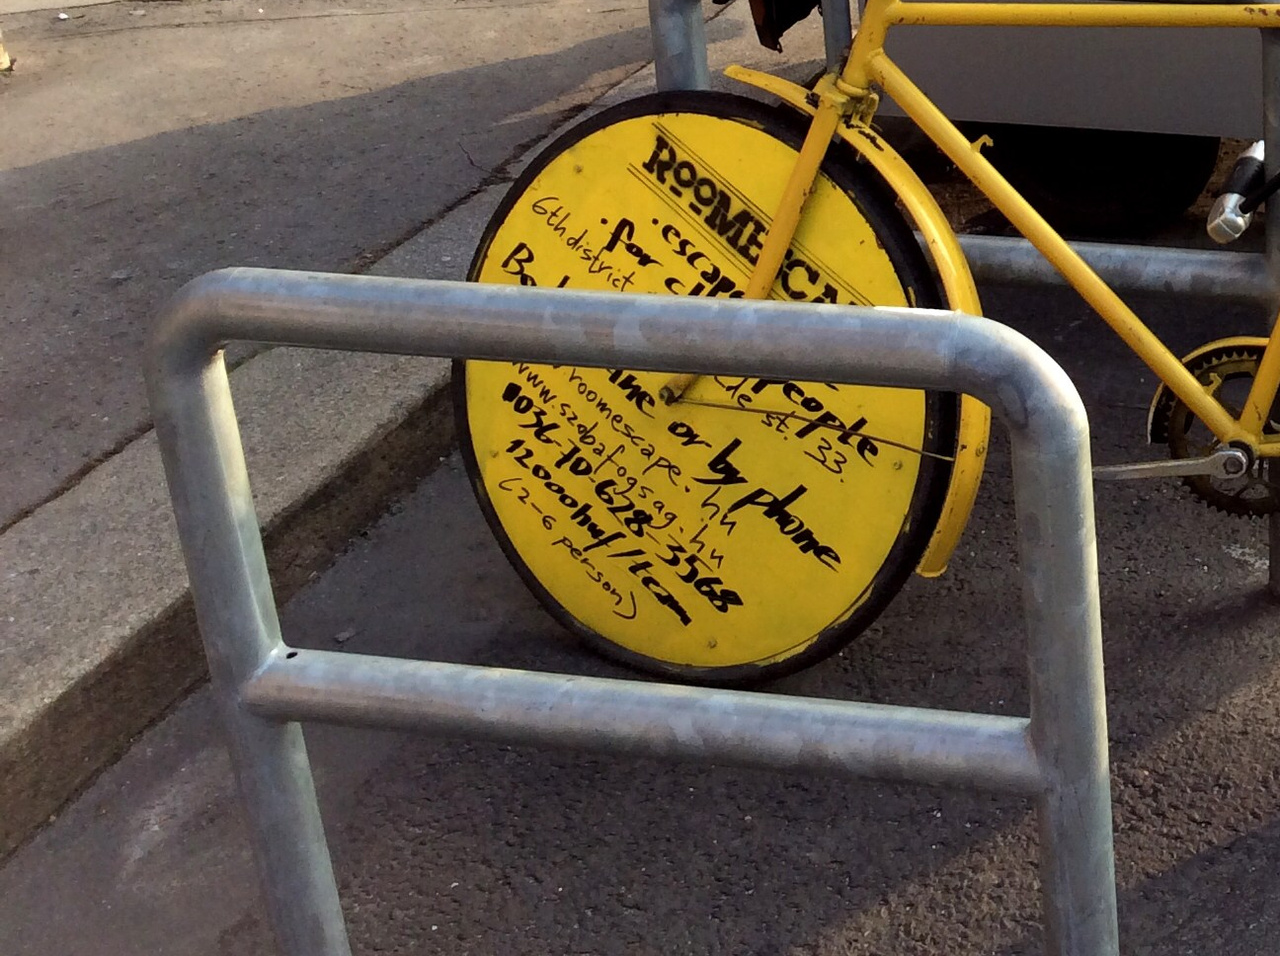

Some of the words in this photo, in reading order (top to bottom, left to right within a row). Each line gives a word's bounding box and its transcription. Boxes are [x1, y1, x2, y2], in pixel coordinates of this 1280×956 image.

[532, 197, 571, 238] 6th
[566, 229, 635, 292] district
[608, 218, 664, 267] for
[667, 421, 712, 449] or
[690, 437, 749, 486] by
[727, 484, 843, 573] phone
